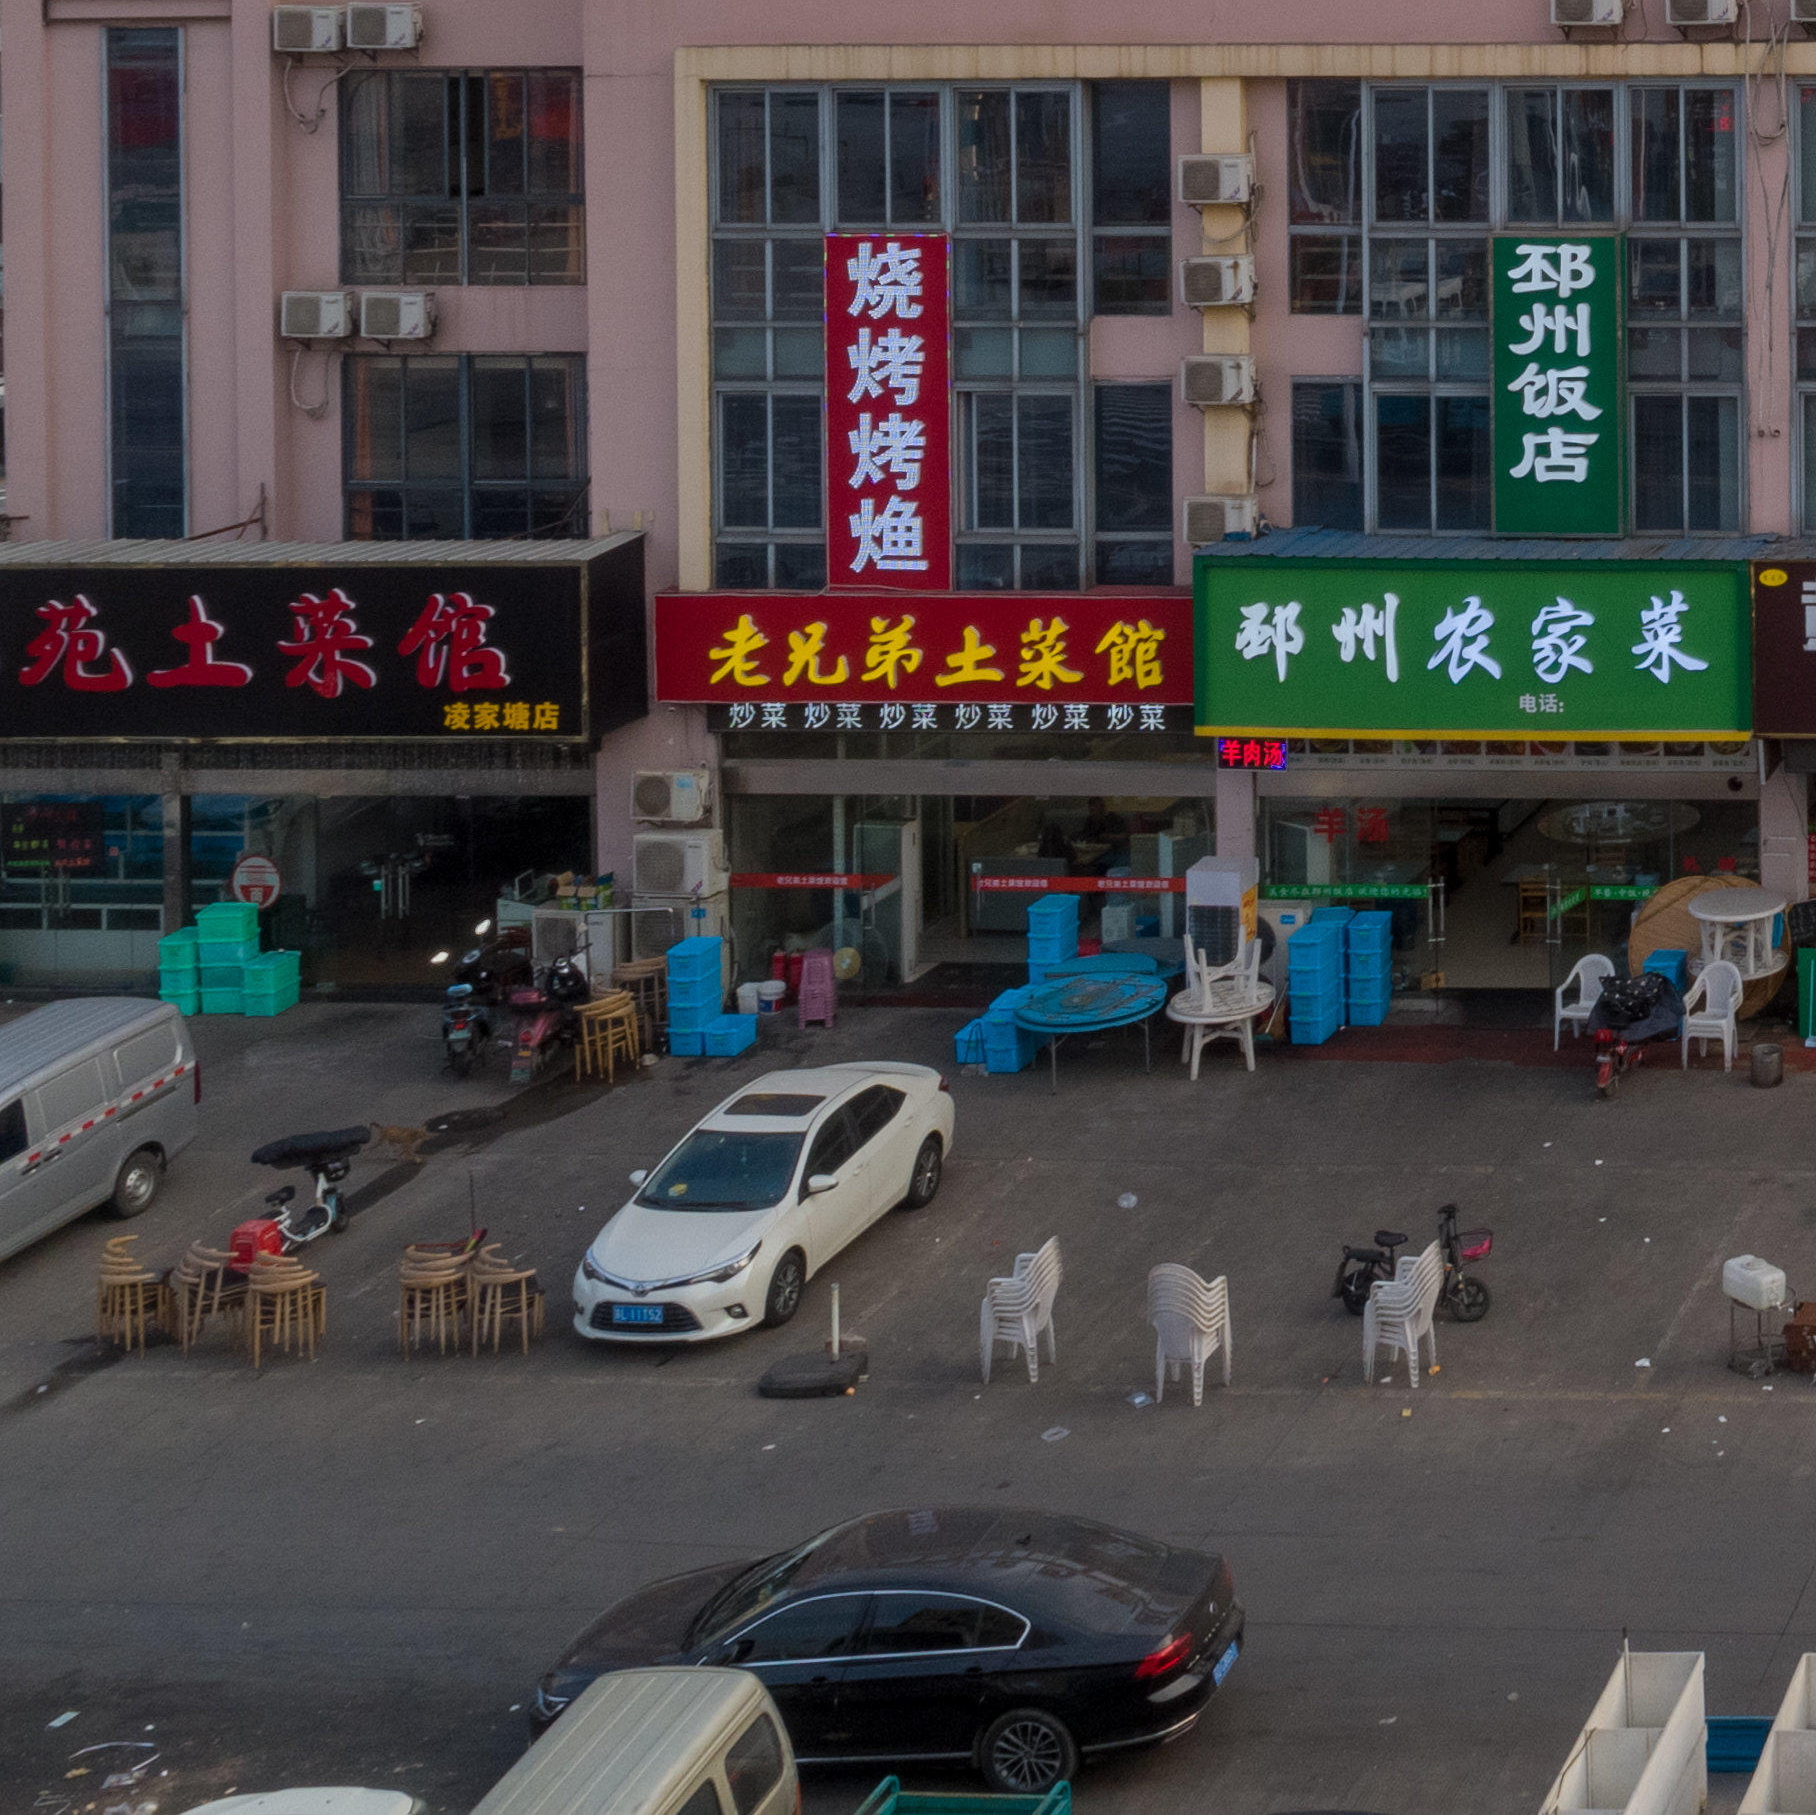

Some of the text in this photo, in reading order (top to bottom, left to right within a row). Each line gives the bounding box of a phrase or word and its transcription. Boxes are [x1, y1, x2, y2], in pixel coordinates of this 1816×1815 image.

[1507, 243, 1603, 484] 邳州饭店
[1235, 589, 1709, 685] 邳州农家菜
[442, 700, 560, 731] 凌家塘店
[728, 701, 1166, 731] 炒菜 炒菜 炒菜 炒菜 炒菜 炒菜
[1220, 739, 1286, 769] 羊肉汤
